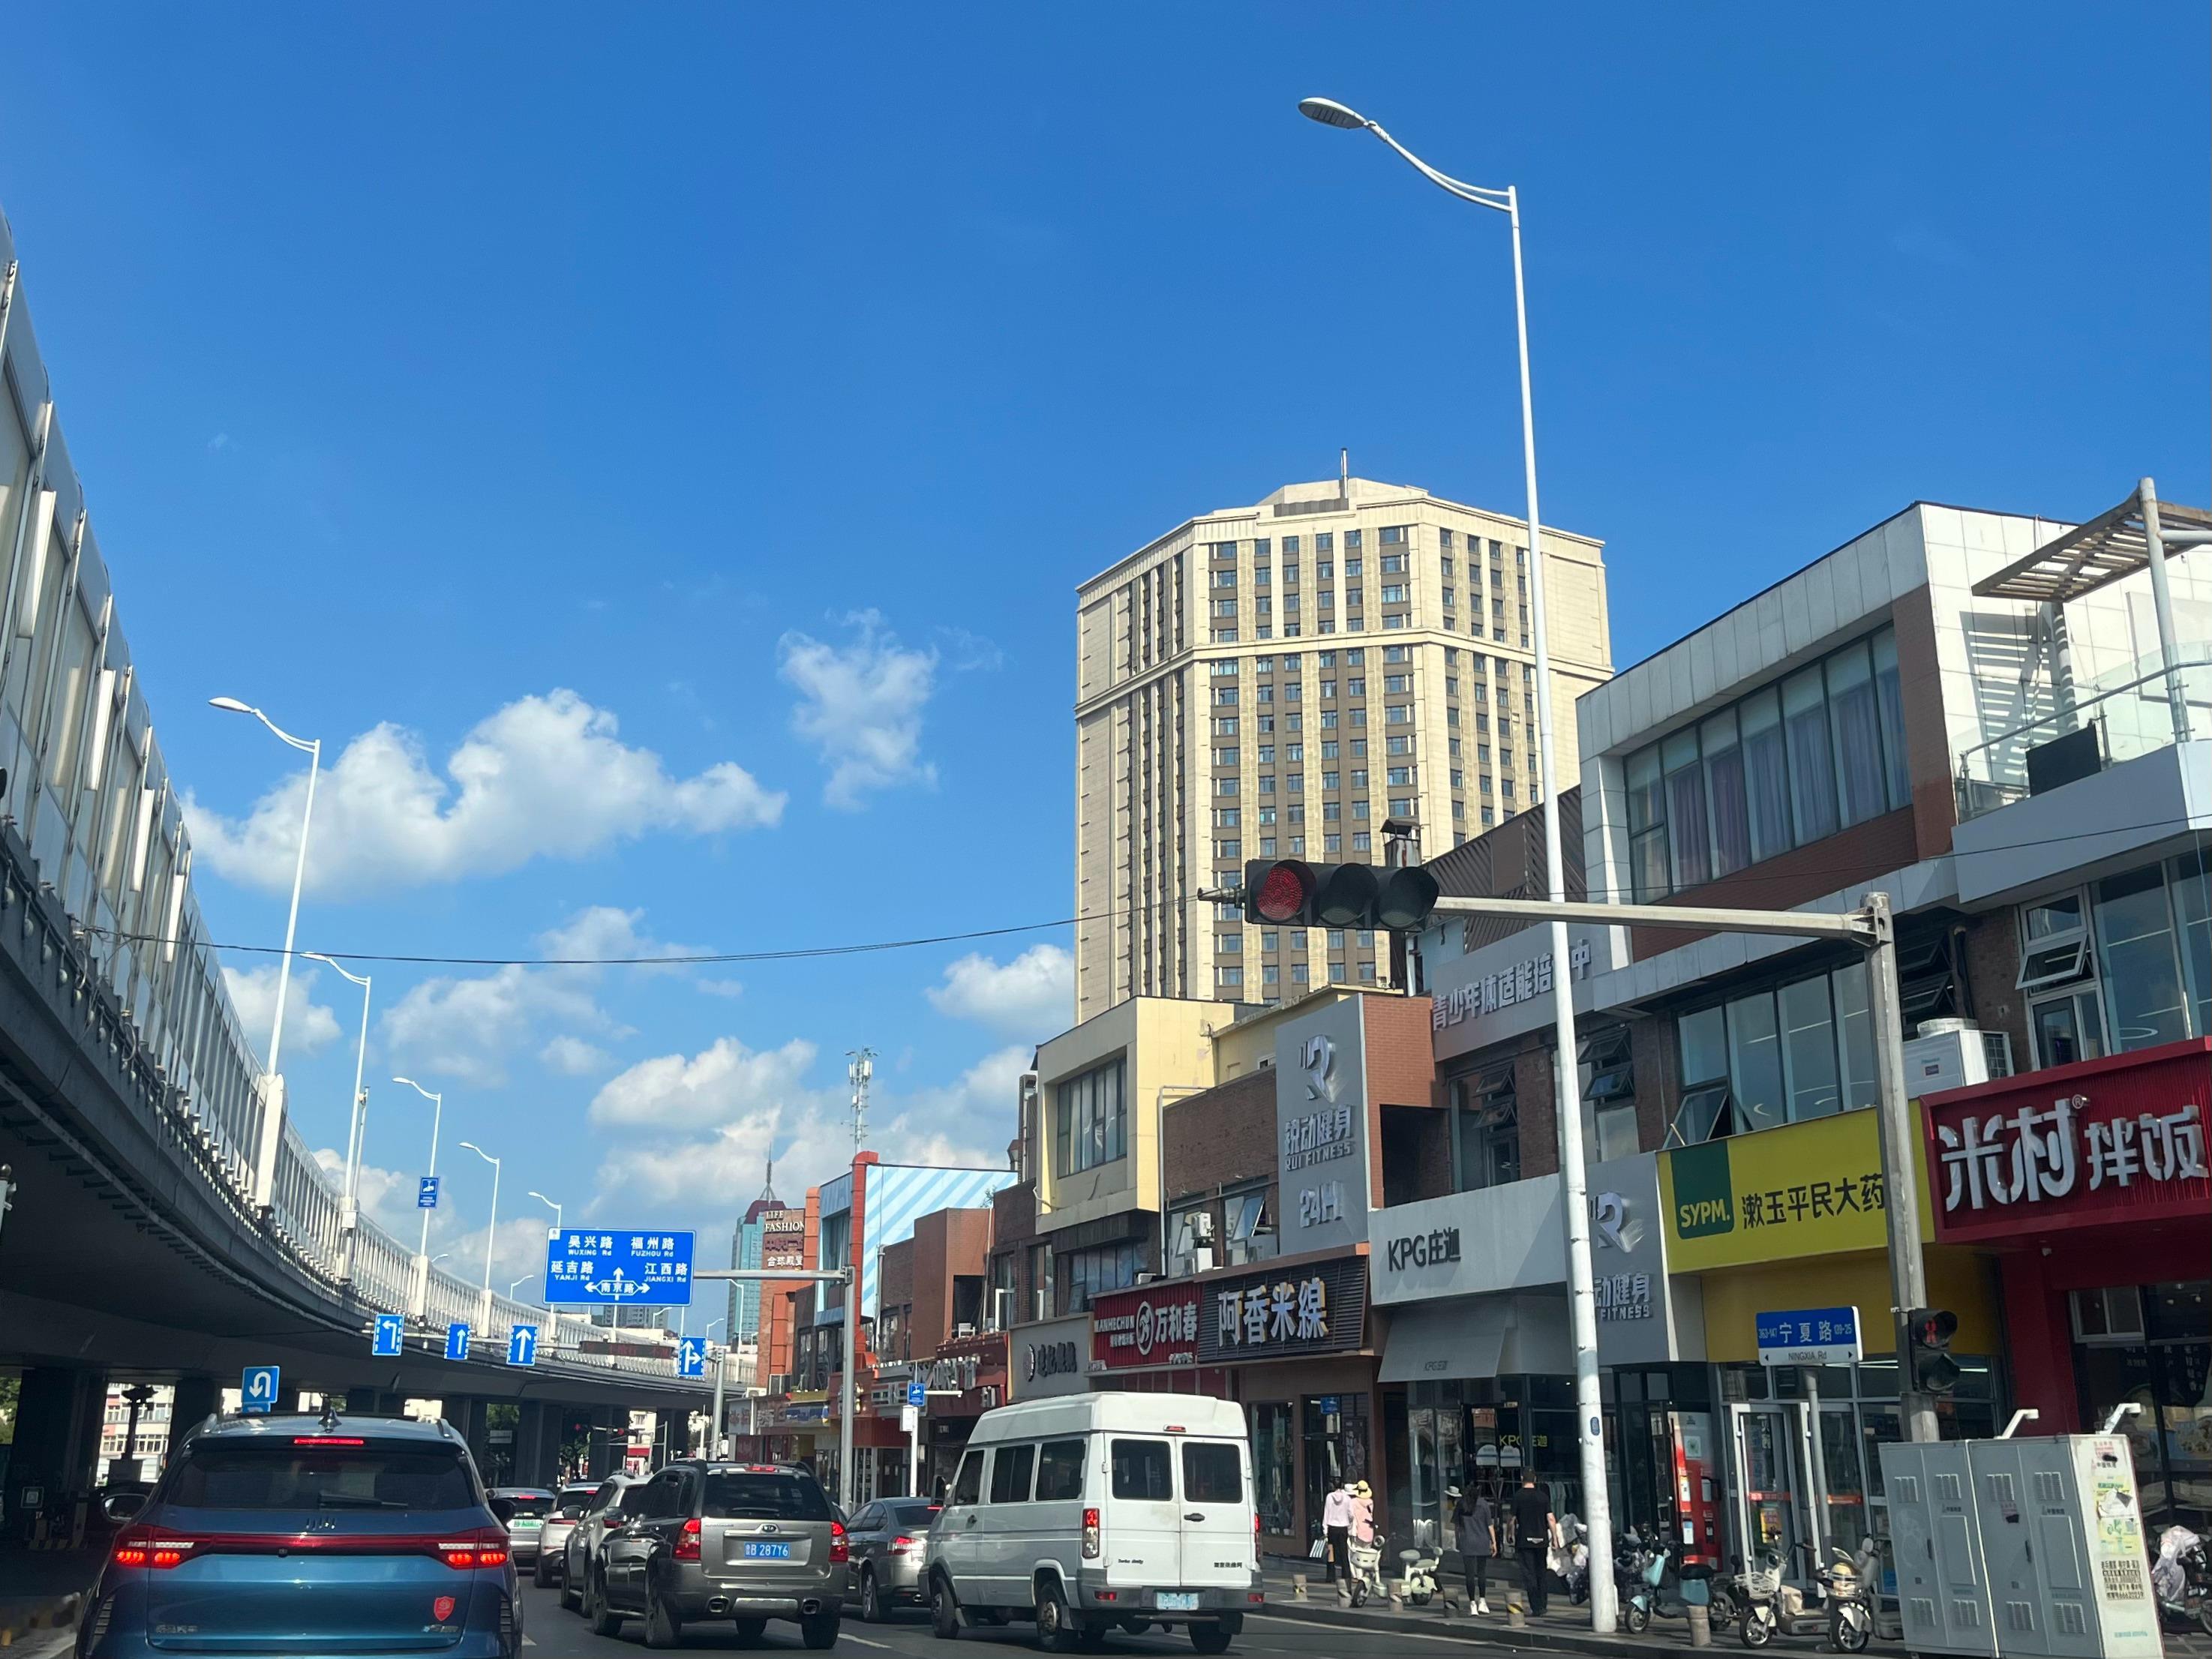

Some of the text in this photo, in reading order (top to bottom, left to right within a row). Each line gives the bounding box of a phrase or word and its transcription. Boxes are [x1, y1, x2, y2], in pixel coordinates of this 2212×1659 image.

[1433, 939, 1591, 1031] 青少年体适能培中
[1284, 1105, 1352, 1156] 锐动健身
[1285, 1142, 1351, 1171] RUI FITNESS
[1938, 1098, 2210, 1212] 米村拌饭
[1300, 1180, 1343, 1228] 24H
[766, 1210, 784, 1220] LIFE
[569, 1235, 613, 1249] 吴兴路
[631, 1237, 674, 1250] 福州路
[551, 1261, 594, 1274] 延吉路
[644, 1262, 688, 1276] 江西路
[601, 1282, 635, 1294] 南京路
[1594, 1272, 1651, 1307] 动健身
[1155, 1300, 1197, 1343] 万和春
[1600, 1304, 1651, 1320] FITNESS
[1779, 1320, 1832, 1343] 宁夏路
[1788, 1351, 1827, 1361] NINGXIA Rd
